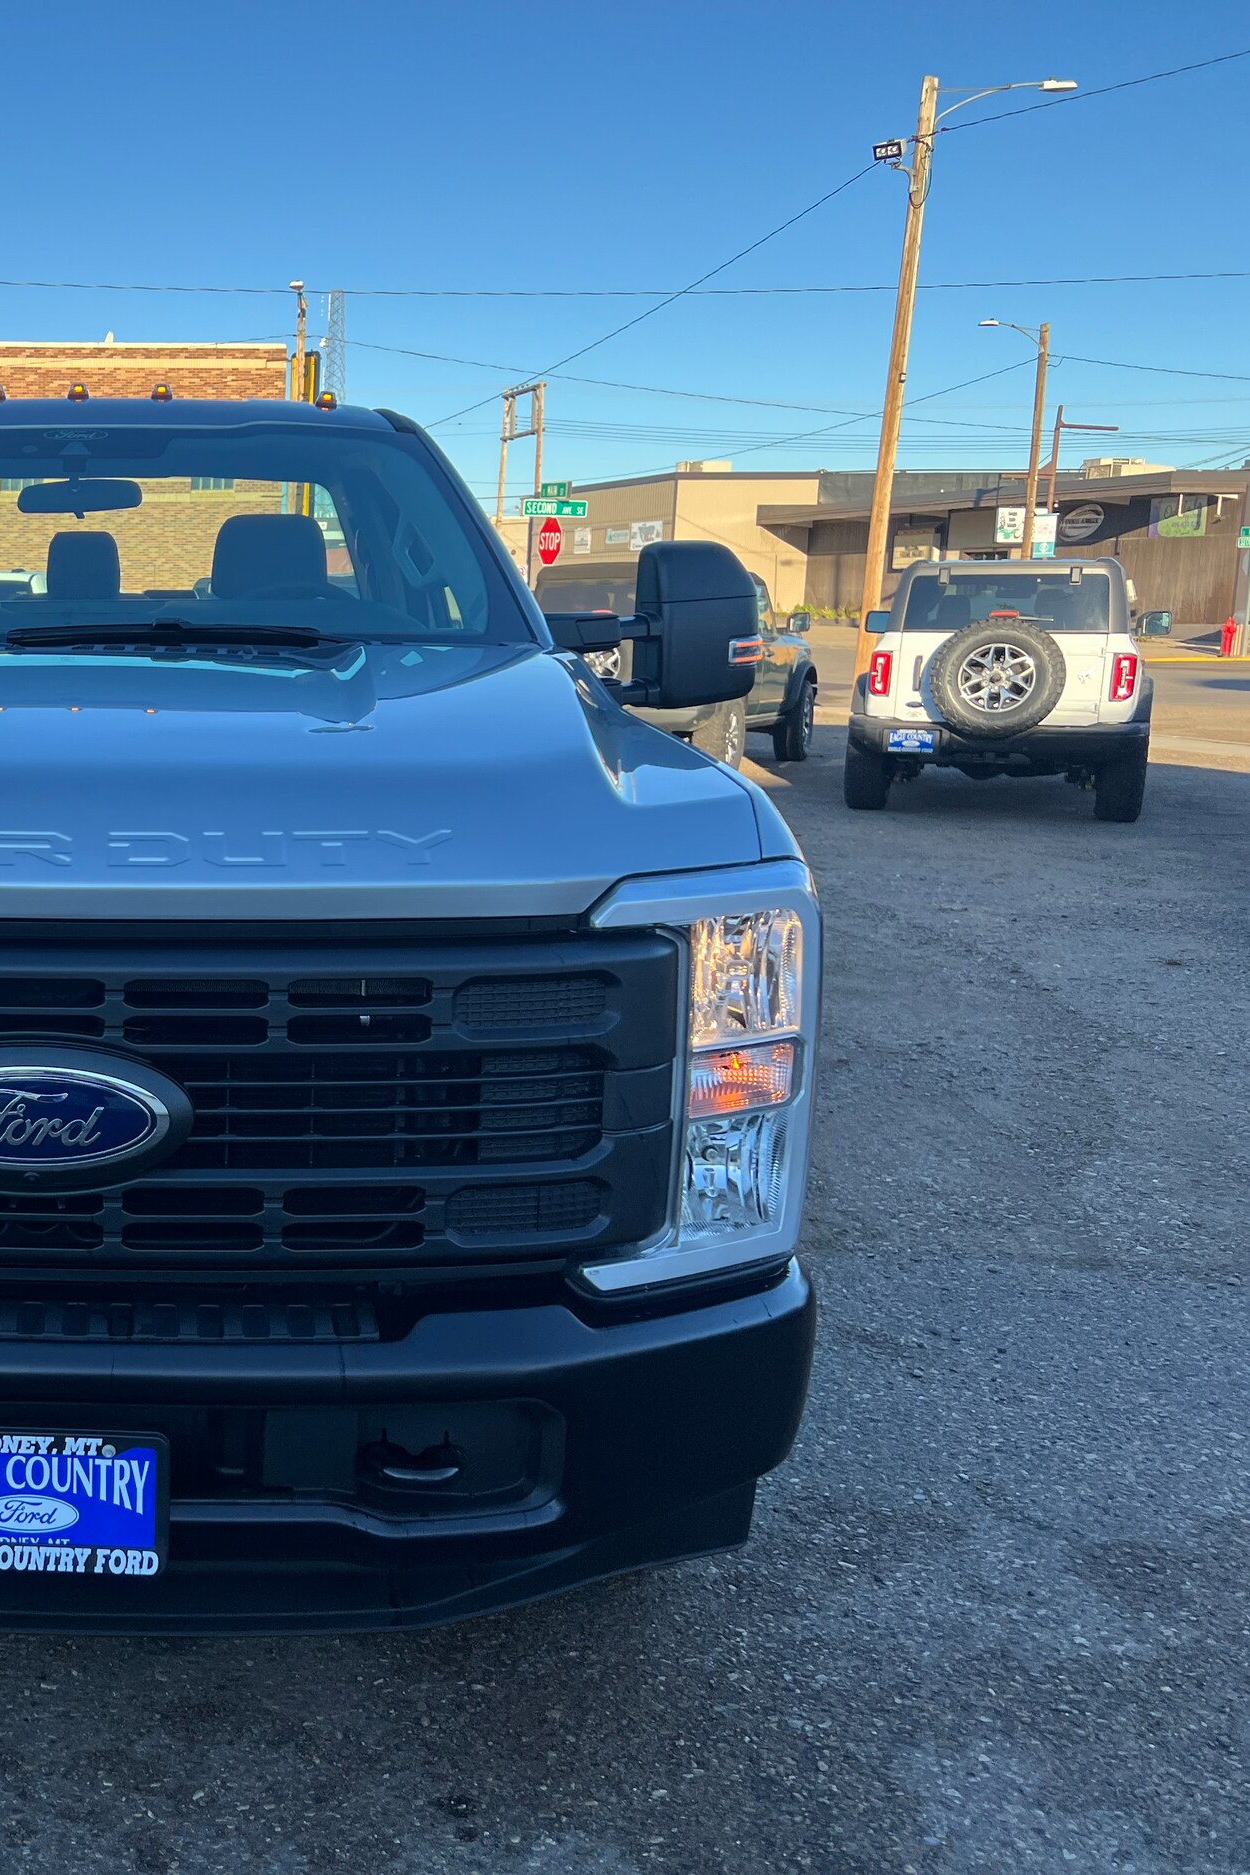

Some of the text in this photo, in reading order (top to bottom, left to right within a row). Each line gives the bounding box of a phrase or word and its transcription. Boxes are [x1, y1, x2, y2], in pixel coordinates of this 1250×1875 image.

[526, 502, 584, 515] SECOND AVE SE
[539, 532, 561, 551] STOP
[107, 829, 453, 867] DUTY
[62, 1437, 103, 1456] MT
[5, 1454, 150, 1516] COUNTRY
[93, 1549, 160, 1576] FORD
